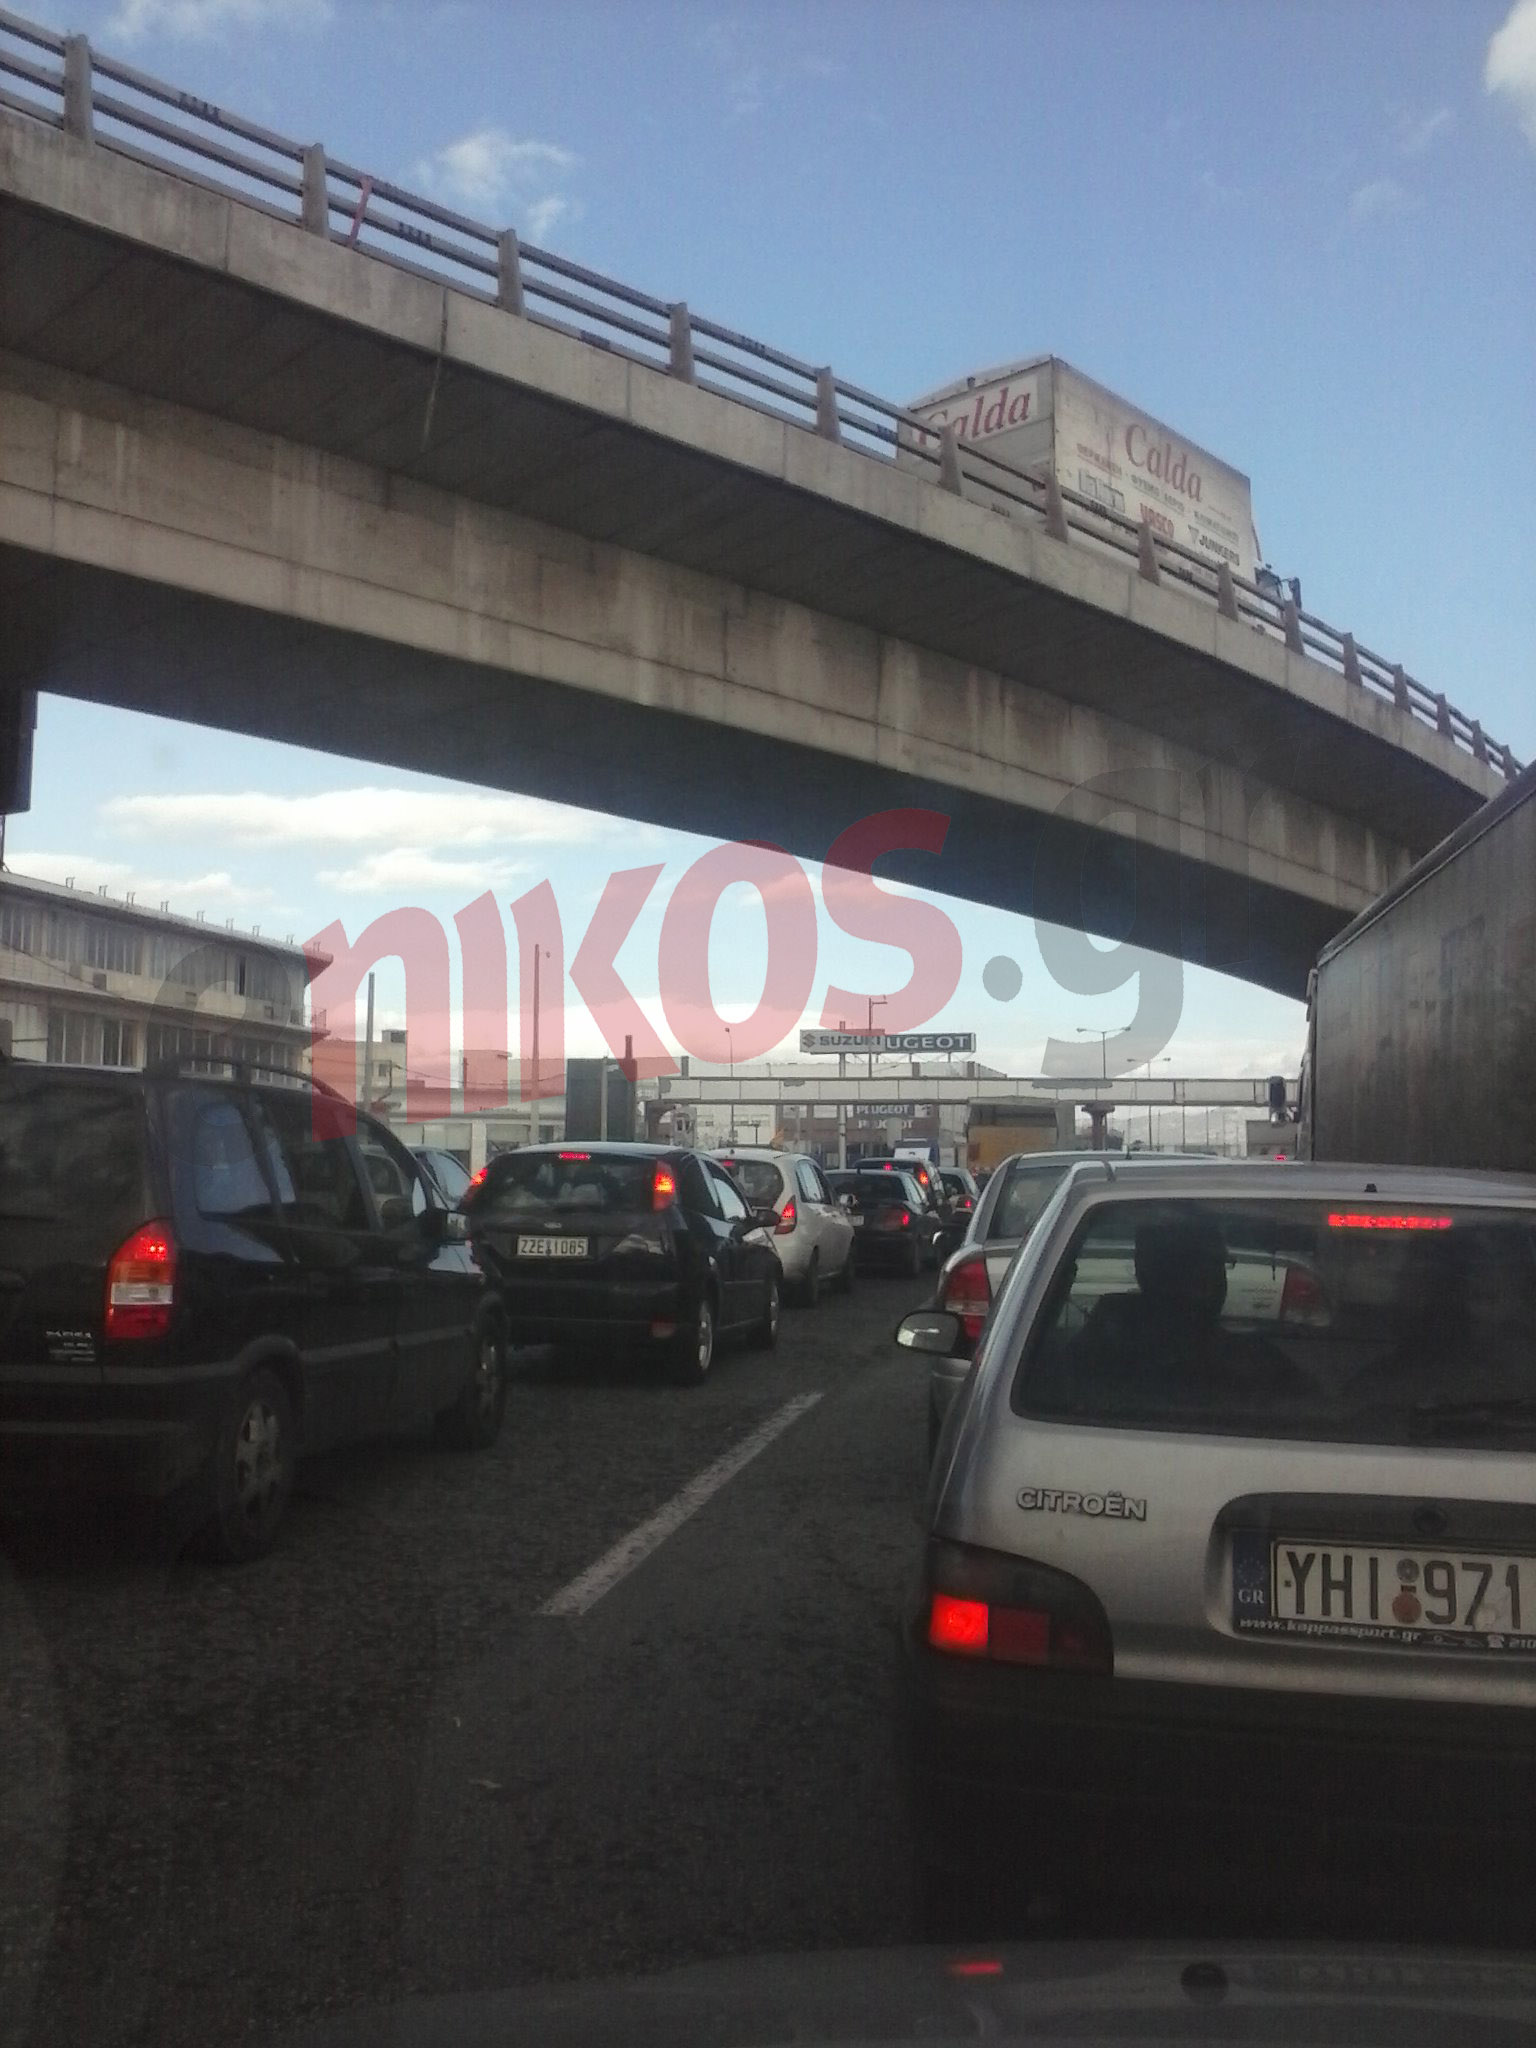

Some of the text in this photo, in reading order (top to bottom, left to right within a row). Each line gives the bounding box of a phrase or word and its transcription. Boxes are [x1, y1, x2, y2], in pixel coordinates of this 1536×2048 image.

[1126, 424, 1202, 502] Calda
[820, 1035, 881, 1046] SUZUKI
[1016, 1486, 1148, 1522] CITROËN
[1238, 1588, 1265, 1604] GR
